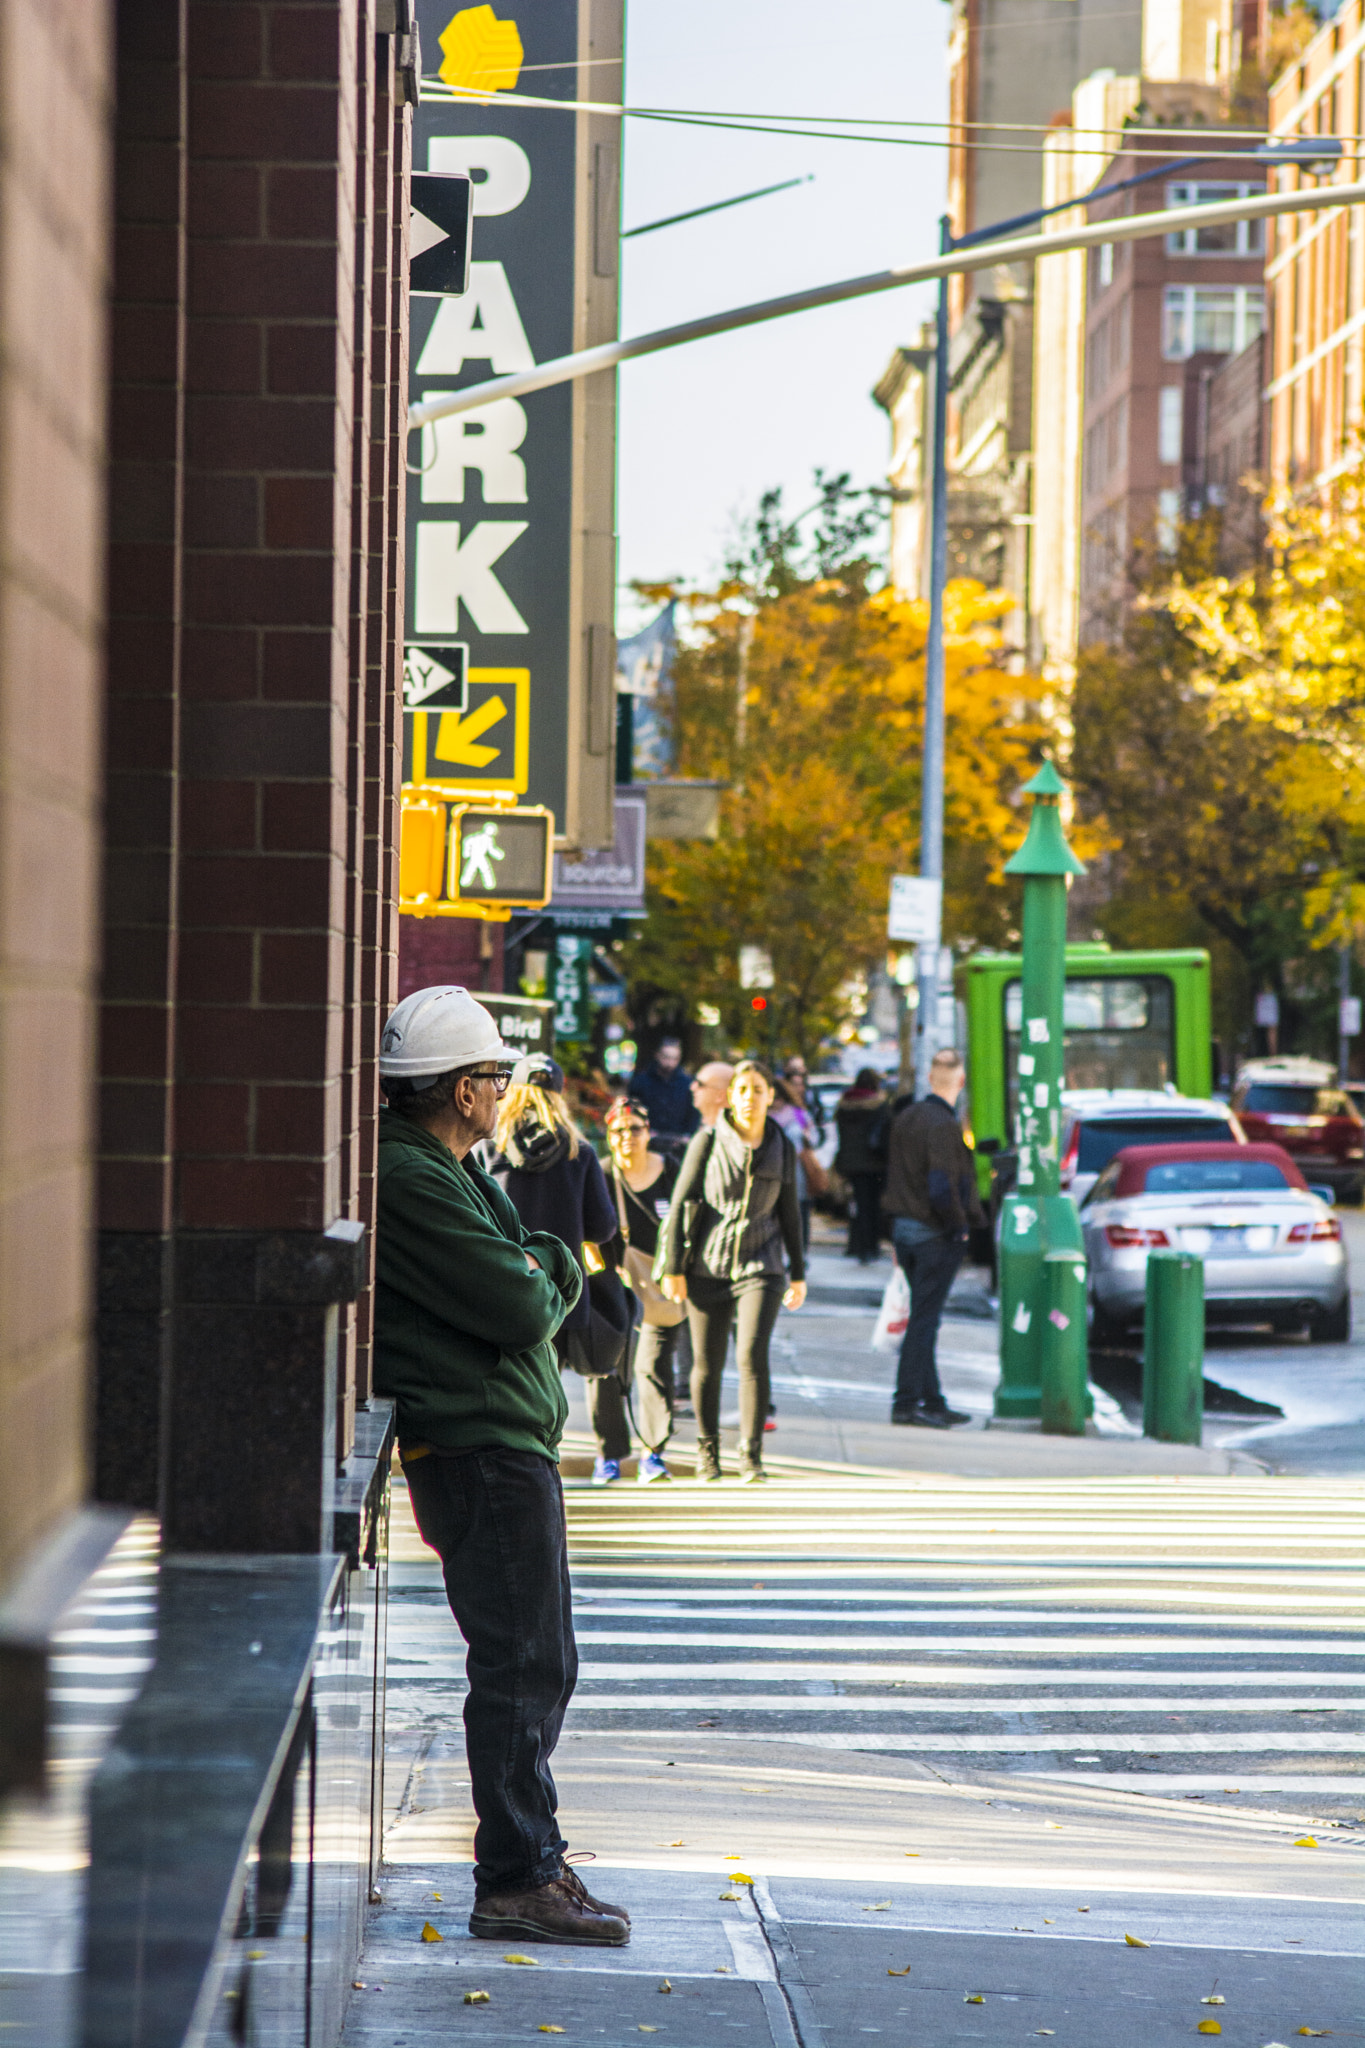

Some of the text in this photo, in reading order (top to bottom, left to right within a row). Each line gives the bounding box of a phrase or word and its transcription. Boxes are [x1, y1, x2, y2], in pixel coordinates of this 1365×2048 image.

[415, 135, 536, 634] PARK
[403, 666, 434, 689] AY
[501, 1015, 542, 1039] Bird
